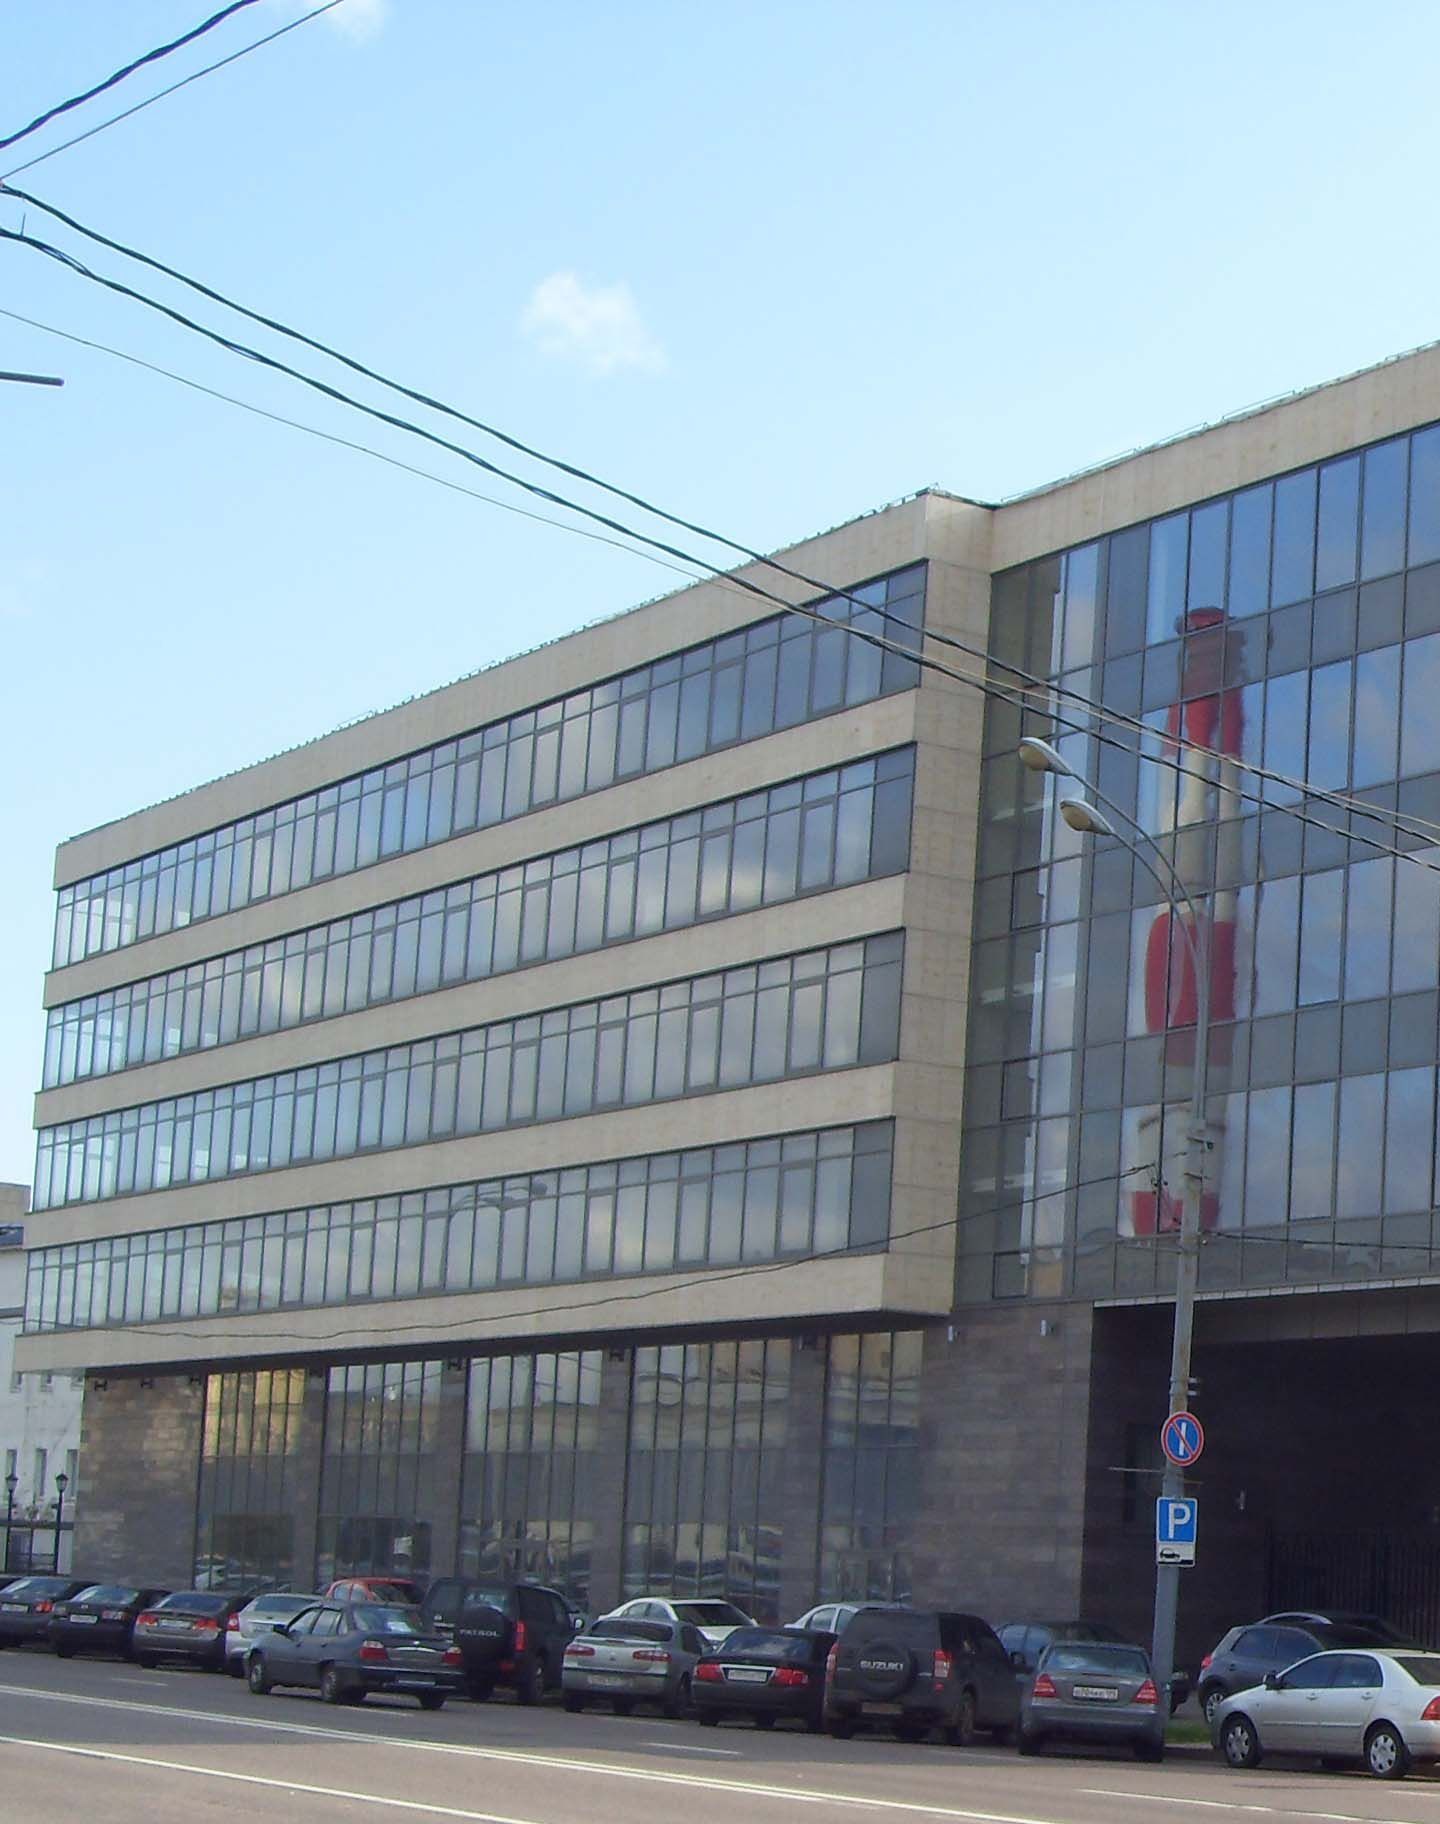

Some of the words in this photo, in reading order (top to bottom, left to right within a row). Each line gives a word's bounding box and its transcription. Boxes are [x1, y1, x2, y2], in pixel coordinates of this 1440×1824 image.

[1168, 1502, 1191, 1539] P
[459, 1628, 498, 1638] PATROL
[860, 1660, 904, 1672] SUZUKI
